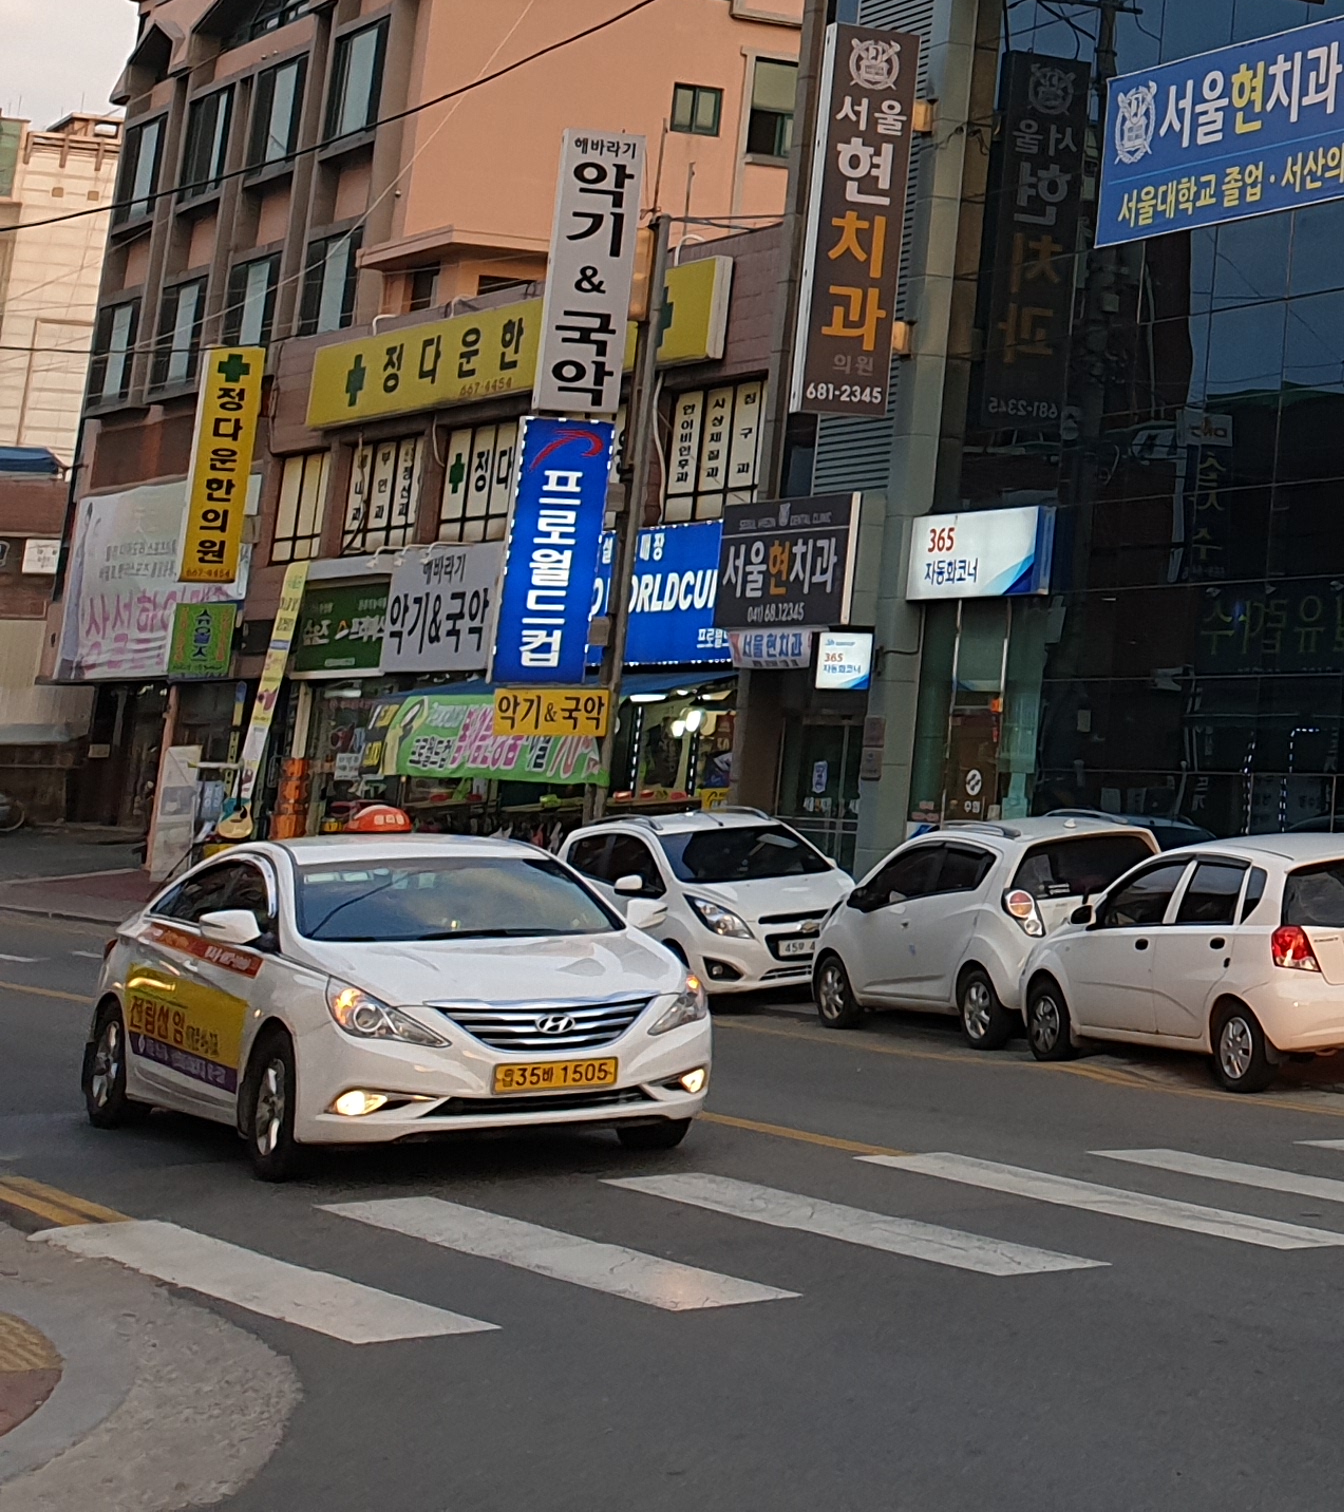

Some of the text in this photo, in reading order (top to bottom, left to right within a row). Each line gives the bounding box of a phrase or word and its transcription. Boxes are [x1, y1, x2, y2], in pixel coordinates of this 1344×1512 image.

[1159, 41, 1342, 147] 서울현치과
[1118, 174, 1216, 228] 서울대학교
[1222, 162, 1264, 207] 졸업
[806, 382, 882, 403] 681-2345
[198, 388, 245, 564] 정다운한의원
[928, 527, 955, 552] 365
[520, 469, 583, 668] 프로월드컵
[722, 537, 837, 598] 서울현치과
[924, 558, 978, 585] 자동화코너
[824, 652, 843, 662] 365
[561, 1063, 608, 1083] 1505
